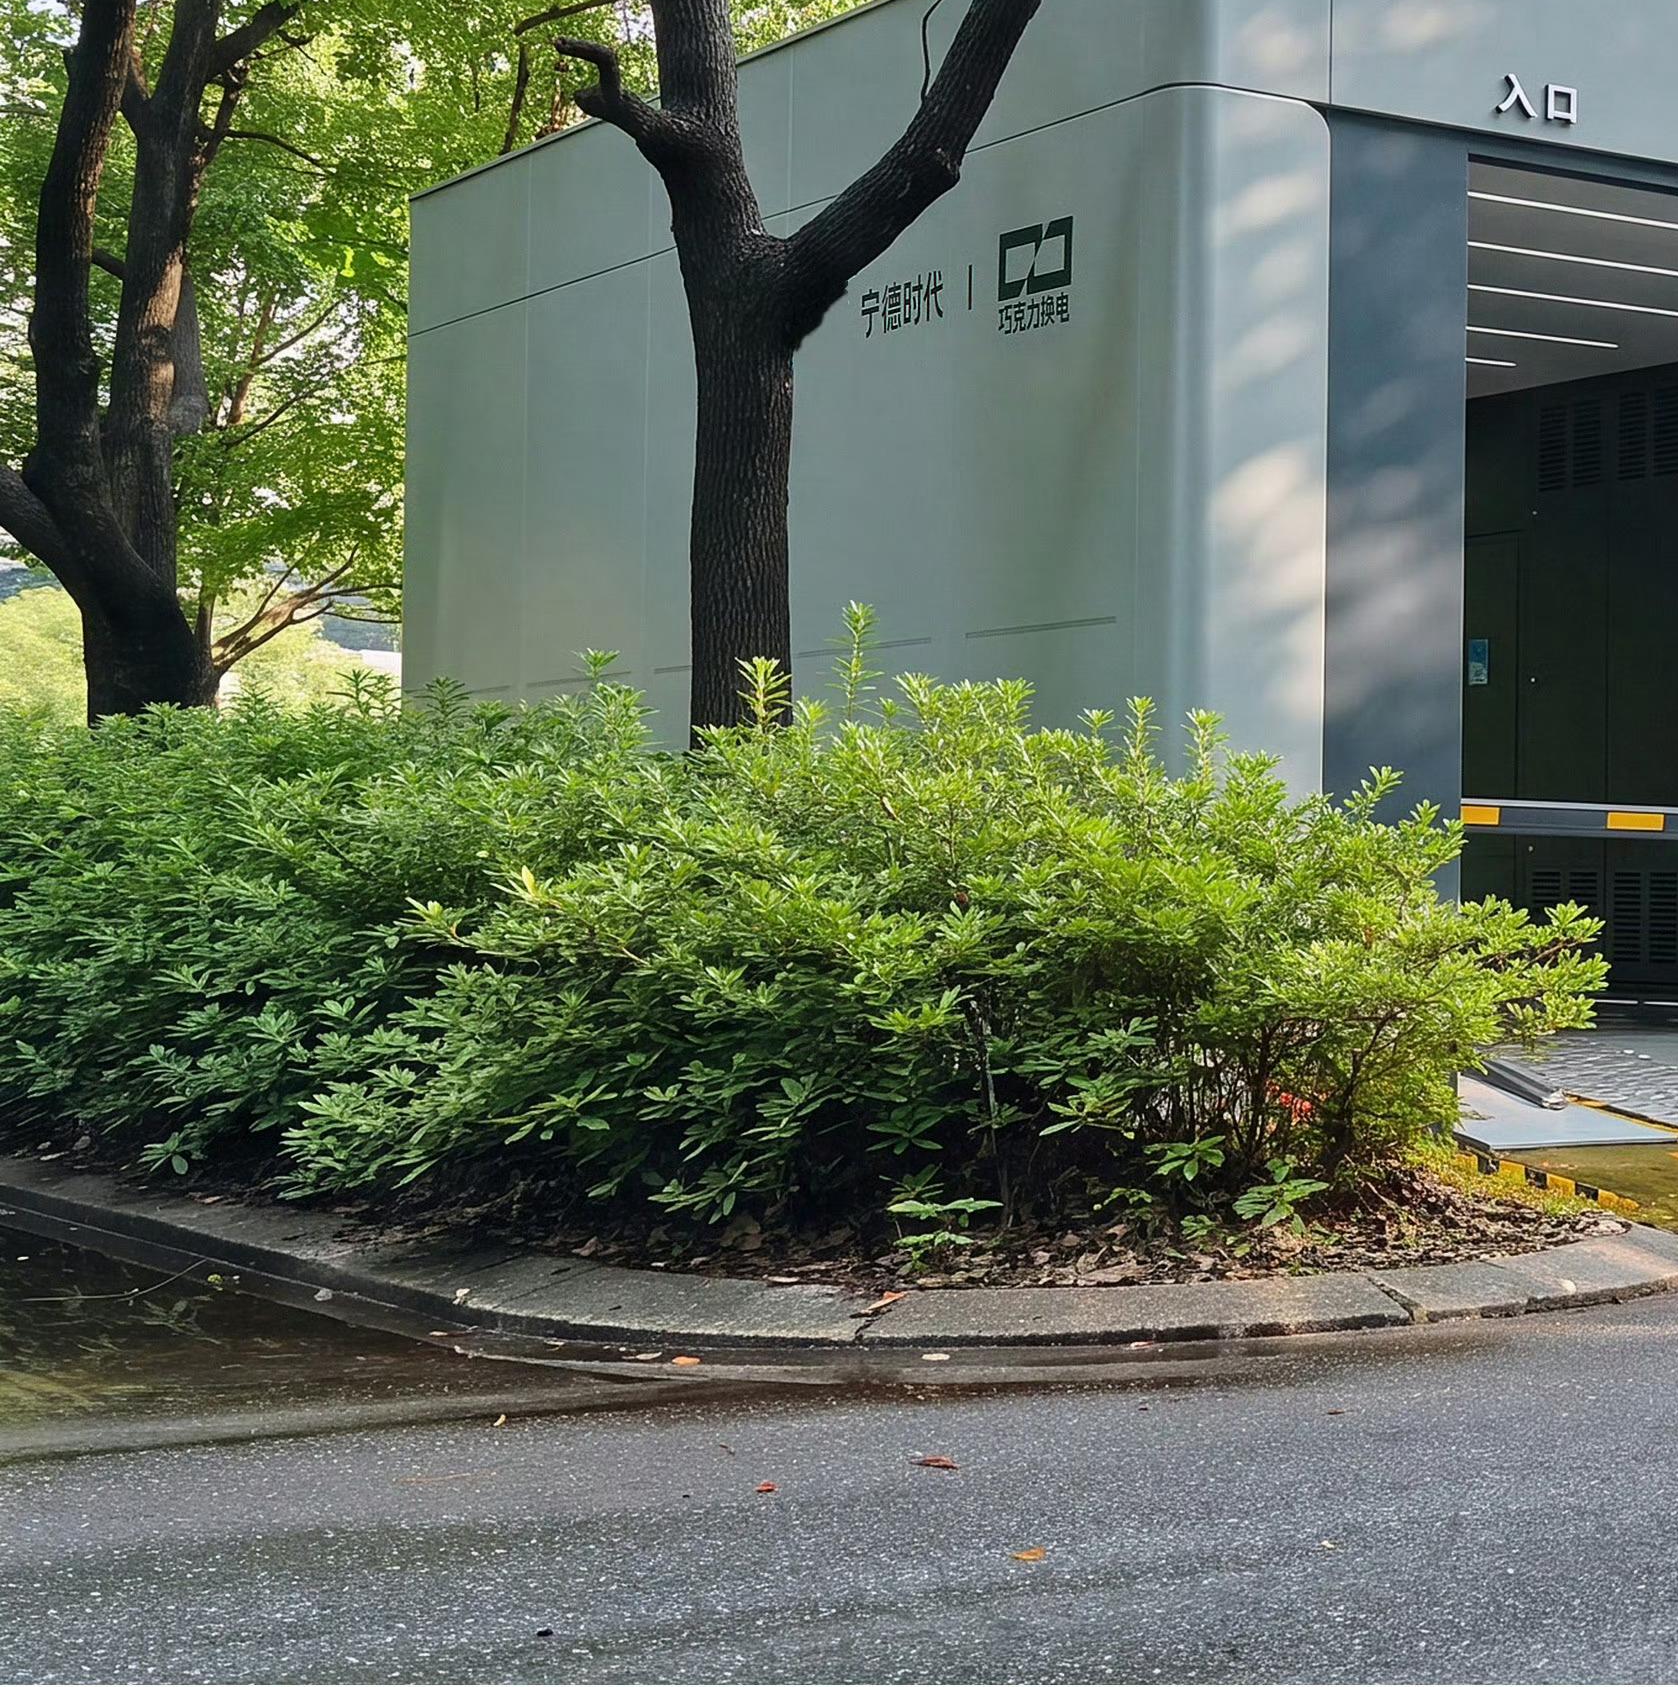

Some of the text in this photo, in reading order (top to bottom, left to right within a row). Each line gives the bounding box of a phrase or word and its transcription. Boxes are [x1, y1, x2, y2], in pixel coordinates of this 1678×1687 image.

[1495, 73, 1578, 124] 入口
[861, 270, 944, 339] 宁德时代
[998, 292, 1070, 335] 巧克力换电
